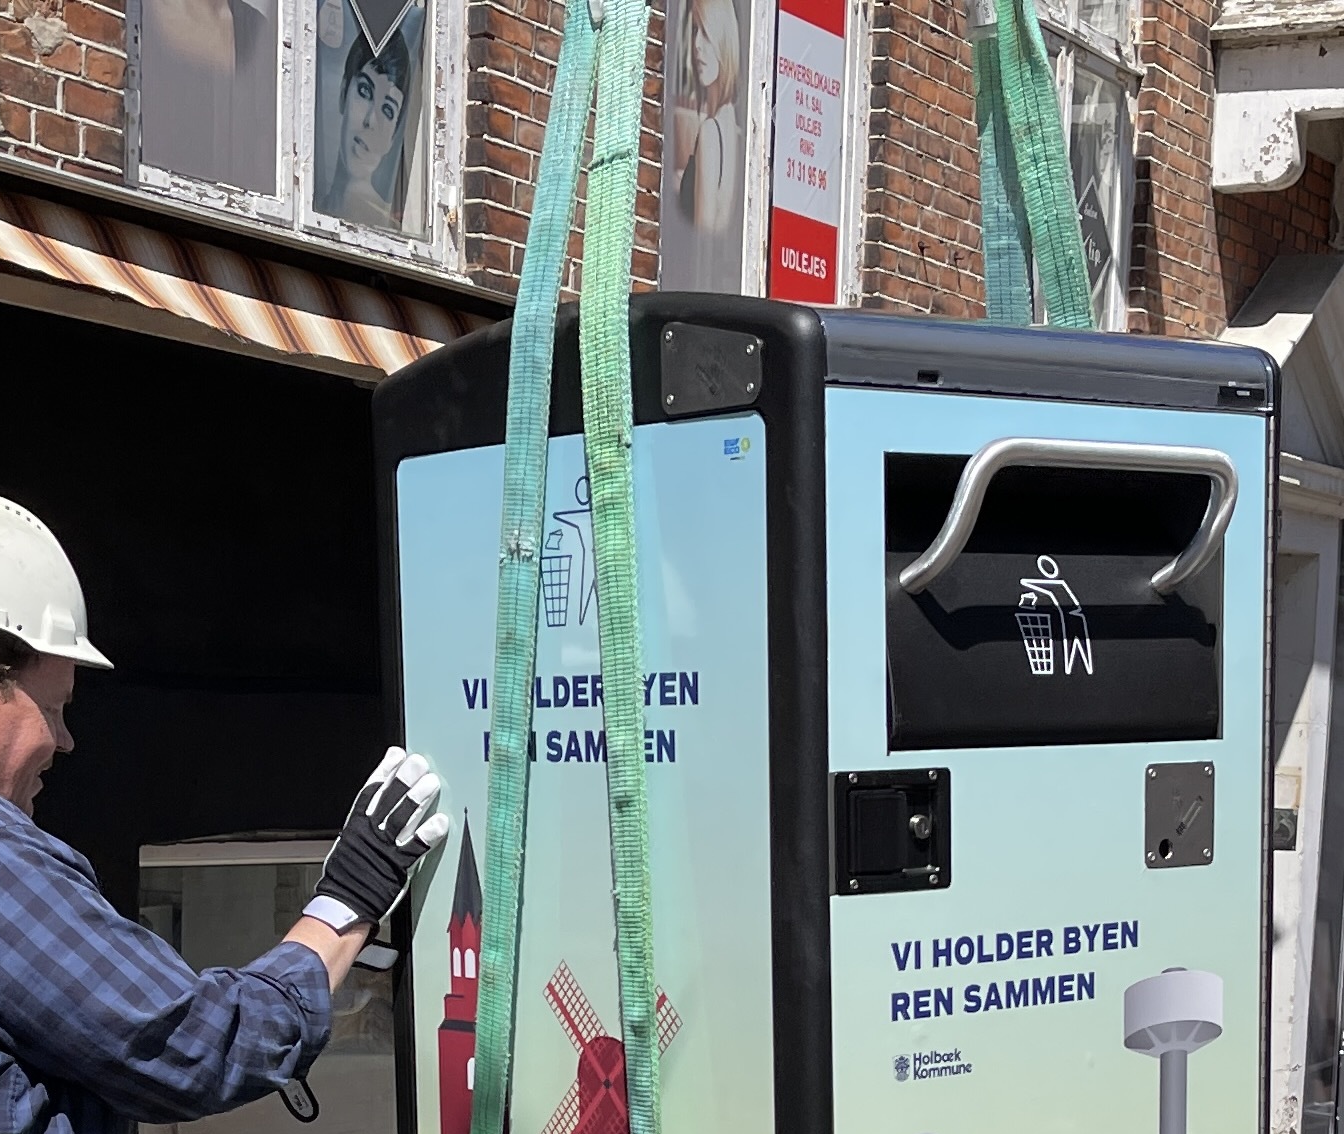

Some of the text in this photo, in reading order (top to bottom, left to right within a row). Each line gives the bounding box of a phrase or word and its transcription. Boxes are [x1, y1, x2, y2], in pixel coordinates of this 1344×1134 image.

[795, 113, 823, 138] UDLEJES
[781, 246, 827, 280] UDLEJES
[462, 678, 488, 709] VI
[642, 671, 699, 706] YEN
[546, 729, 676, 763] SAMEN
[891, 920, 1139, 971] VI HOLDER BYEN
[891, 971, 1095, 1022] REN SAMMEN
[913, 1048, 961, 1067] Holbæk
[913, 1062, 973, 1081] Kommune
